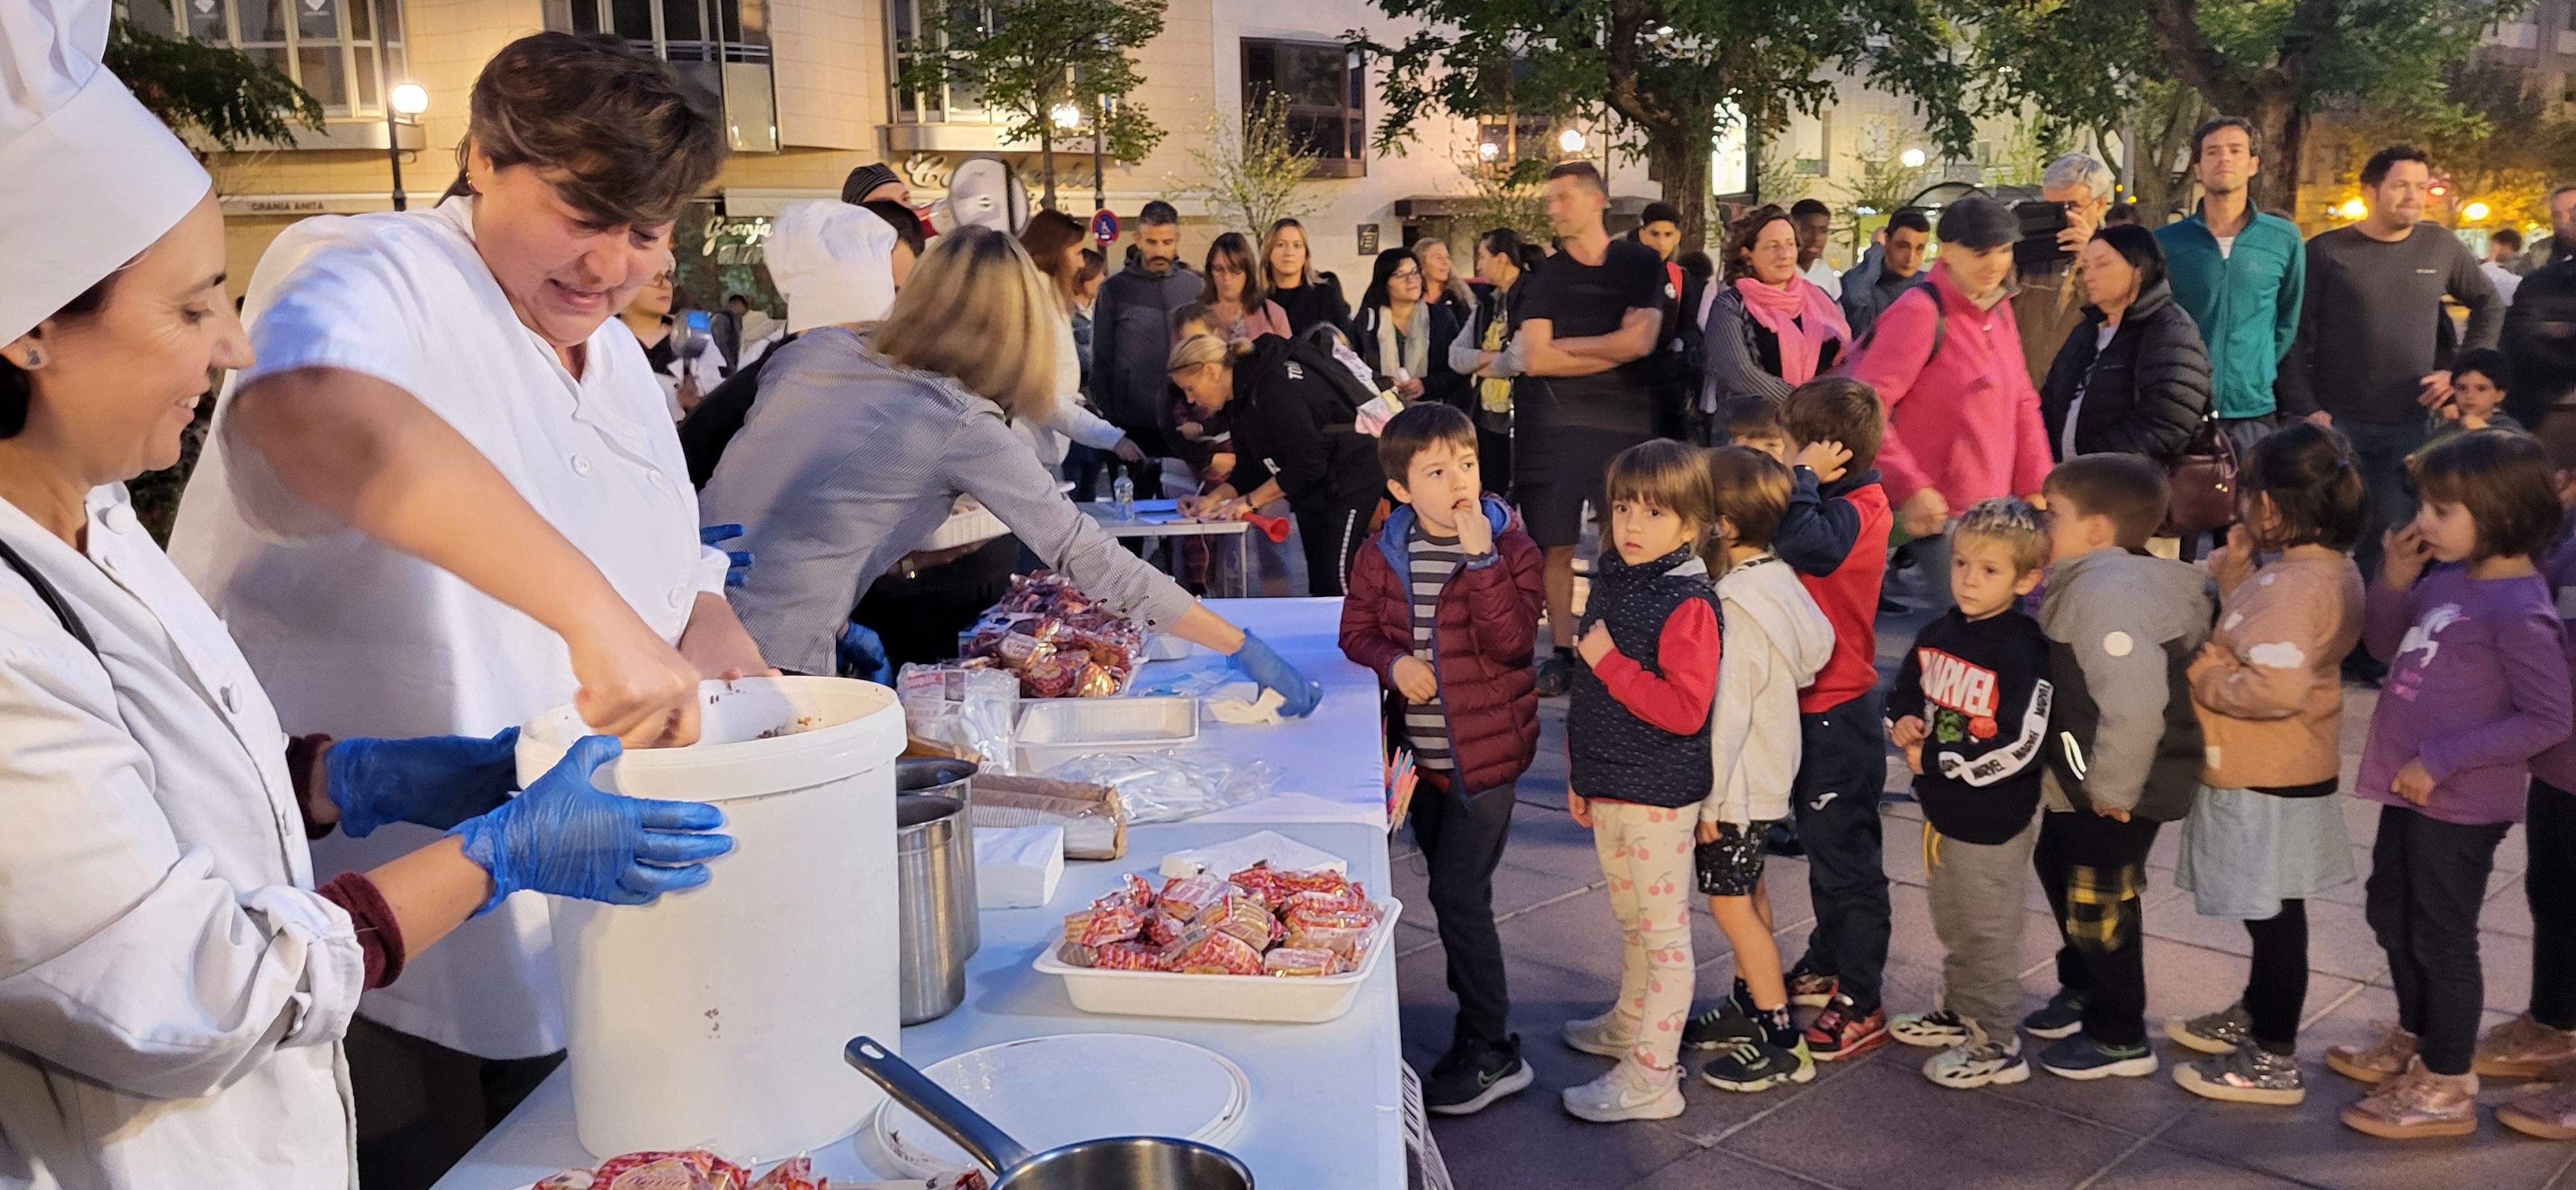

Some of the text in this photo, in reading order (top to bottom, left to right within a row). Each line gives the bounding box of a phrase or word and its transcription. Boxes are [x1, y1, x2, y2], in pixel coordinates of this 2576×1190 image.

[251, 201, 324, 211] GRANJA ANITA
[702, 214, 774, 256] Granja
[1918, 650, 1996, 717] MARVEL
